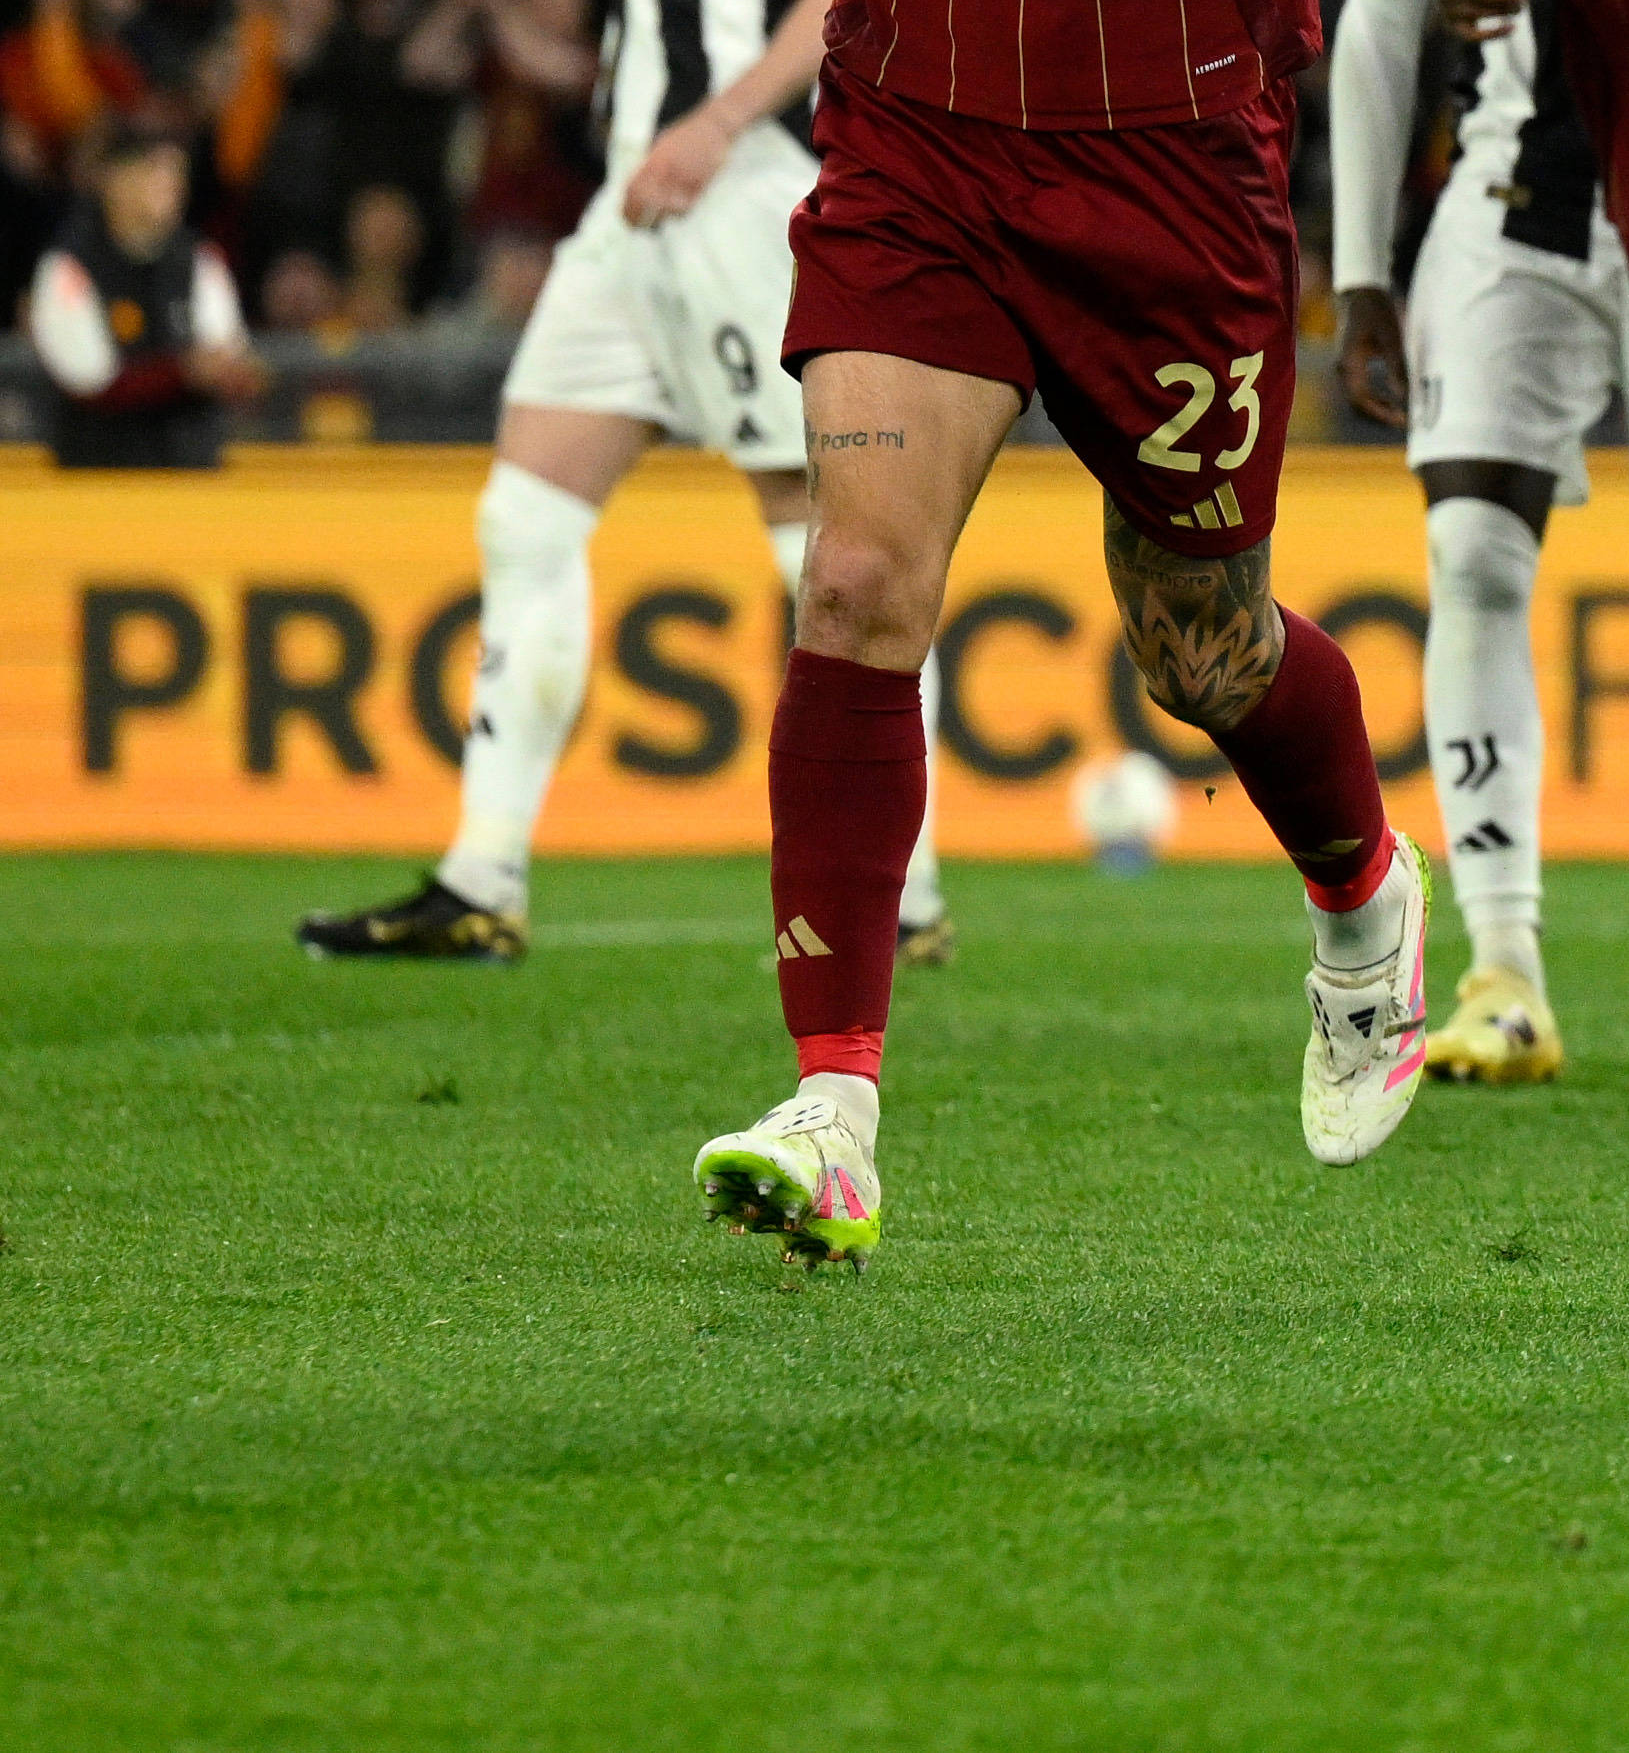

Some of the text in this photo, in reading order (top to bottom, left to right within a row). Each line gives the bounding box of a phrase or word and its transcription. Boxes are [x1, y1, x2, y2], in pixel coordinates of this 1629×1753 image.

[714, 323, 761, 397] 9
[1137, 351, 1264, 473] 23
[80, 577, 1432, 784] PROSCC
